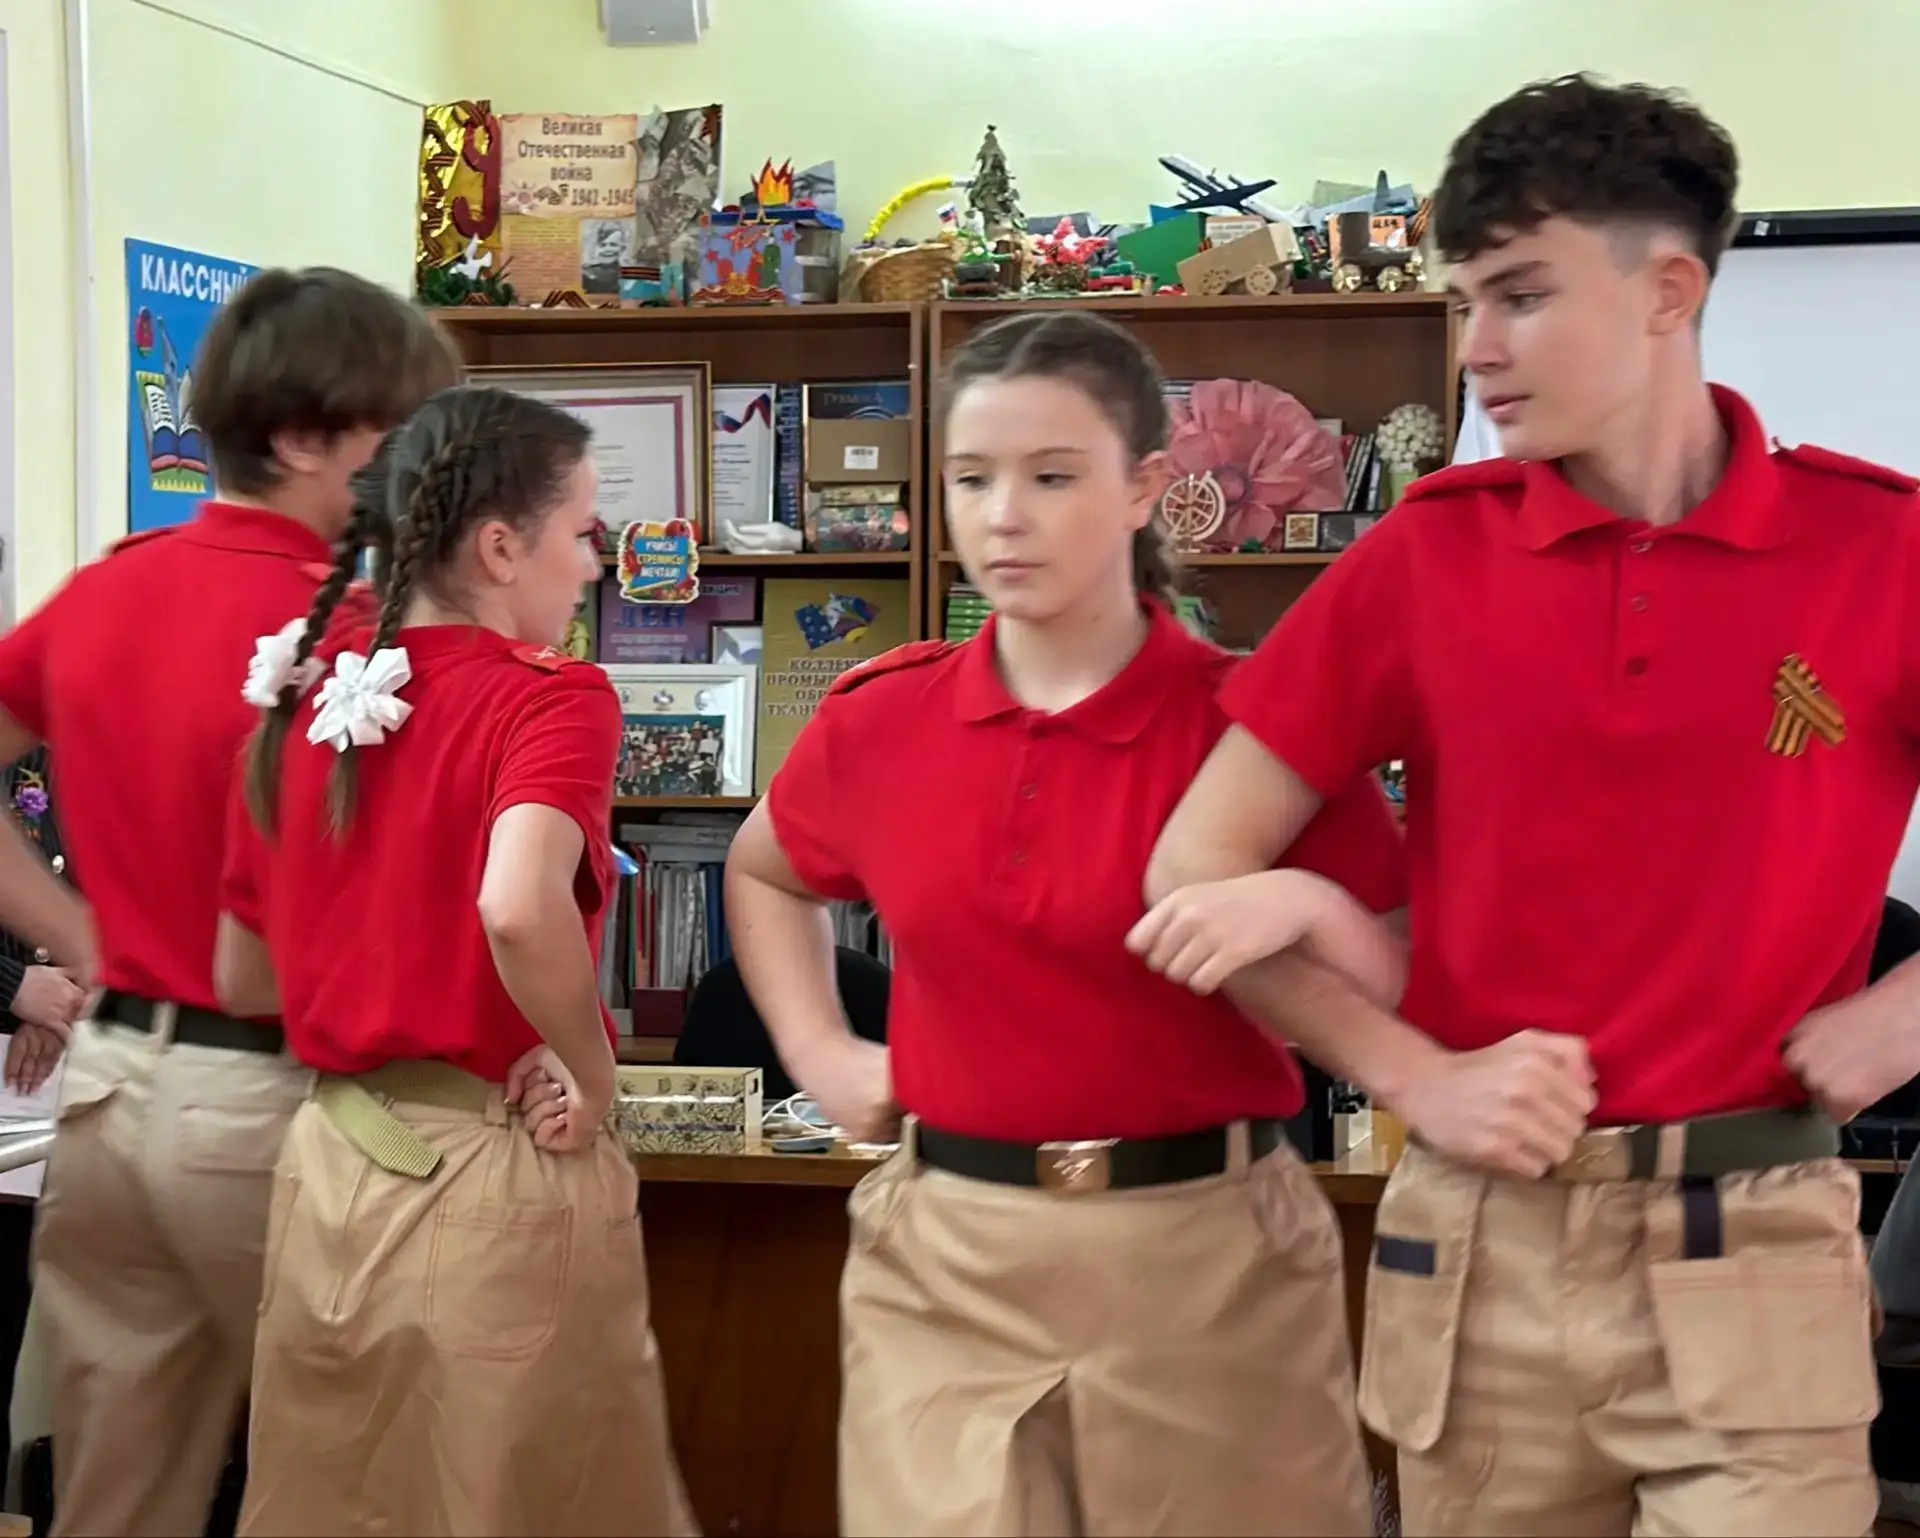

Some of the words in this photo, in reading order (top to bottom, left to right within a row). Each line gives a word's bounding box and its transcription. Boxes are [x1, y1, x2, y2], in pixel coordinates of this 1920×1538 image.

[542, 117, 602, 135] Великая
[518, 140, 625, 158] Отечественная
[550, 162, 592, 181] война
